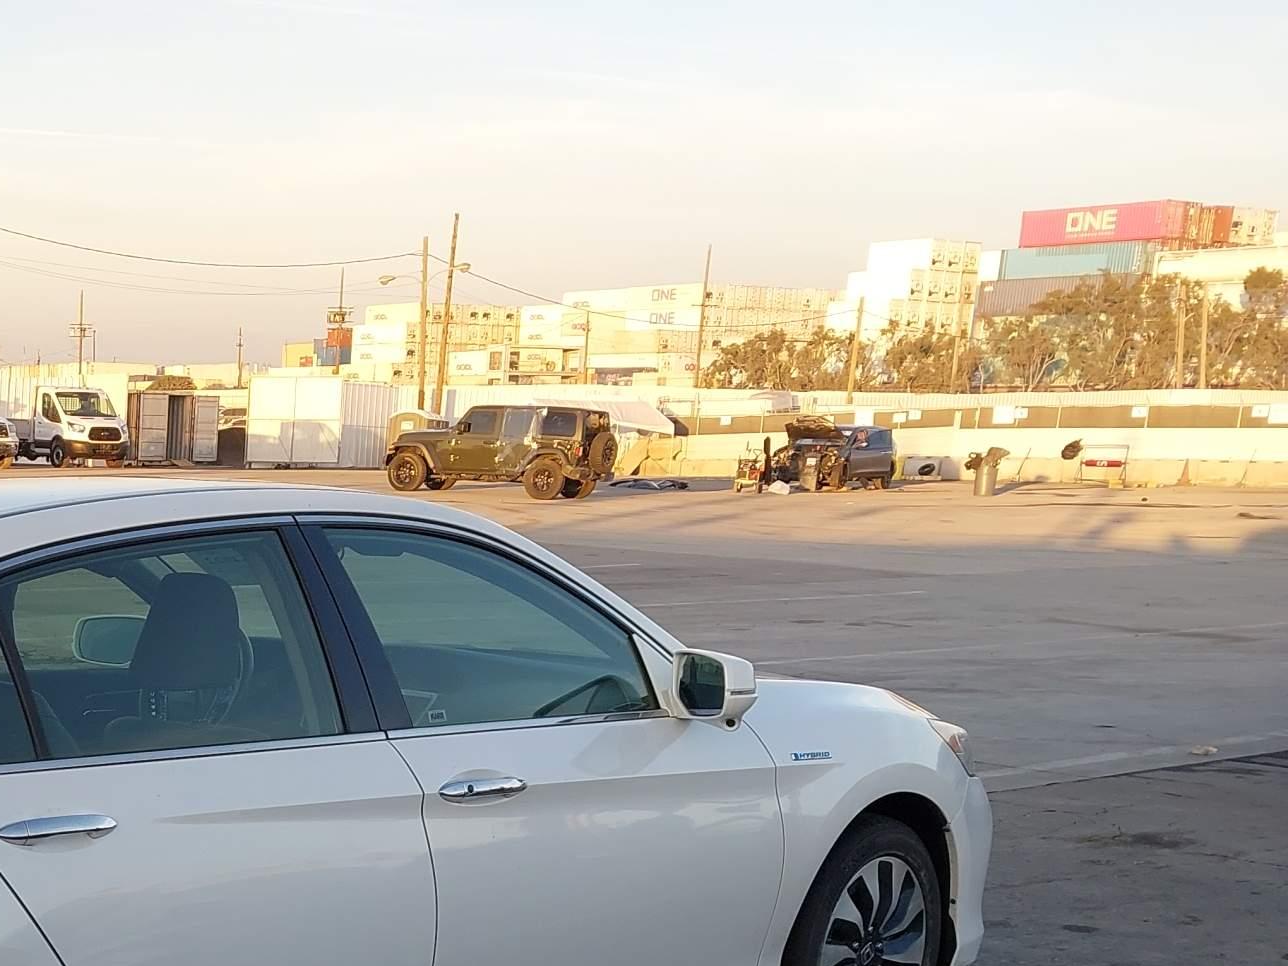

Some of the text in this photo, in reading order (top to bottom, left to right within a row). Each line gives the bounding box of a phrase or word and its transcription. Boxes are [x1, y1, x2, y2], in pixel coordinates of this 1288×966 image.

[1065, 208, 1118, 233] ONE
[651, 287, 678, 302] ONE
[649, 311, 676, 325] ONE
[798, 751, 831, 760] HYBRID
